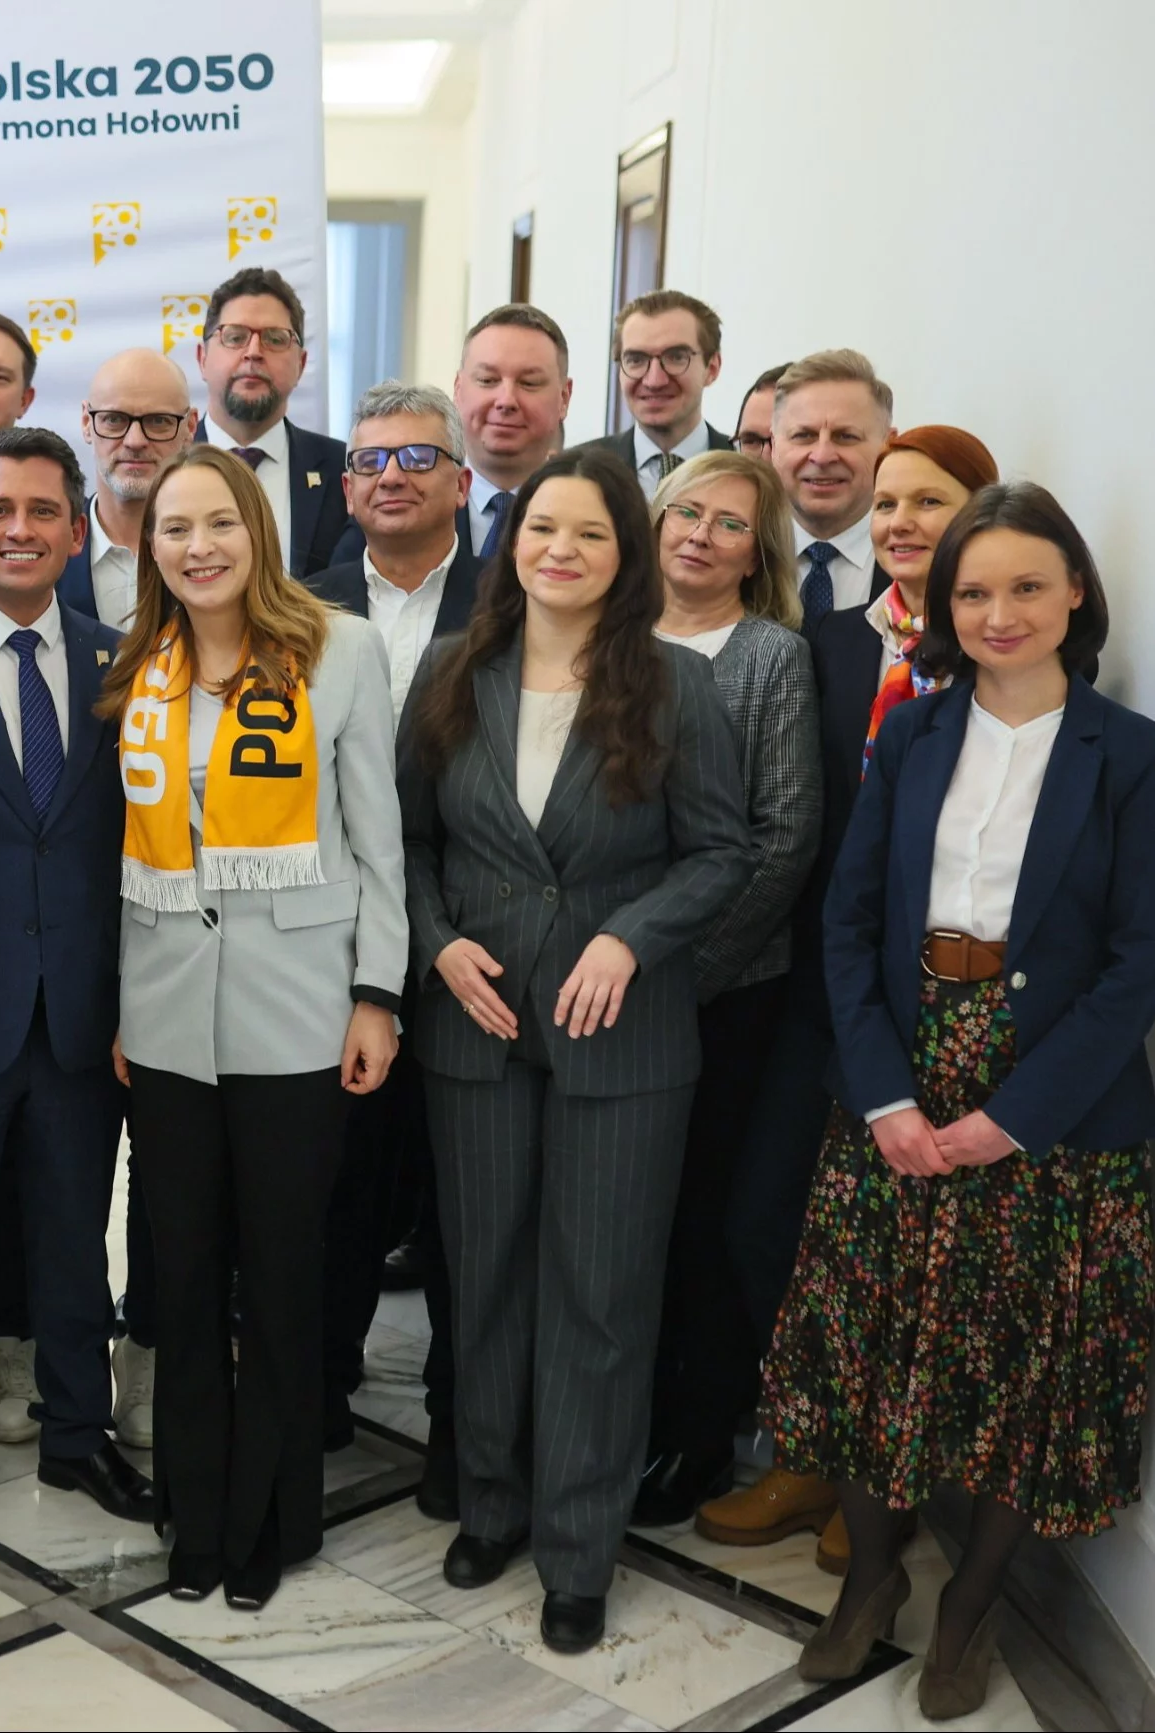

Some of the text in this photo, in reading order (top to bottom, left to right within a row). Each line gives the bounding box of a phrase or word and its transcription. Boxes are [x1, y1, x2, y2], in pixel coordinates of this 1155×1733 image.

[133, 52, 274, 96] 2050
[107, 104, 240, 135] Hołowni
[230, 664, 303, 778] PO
